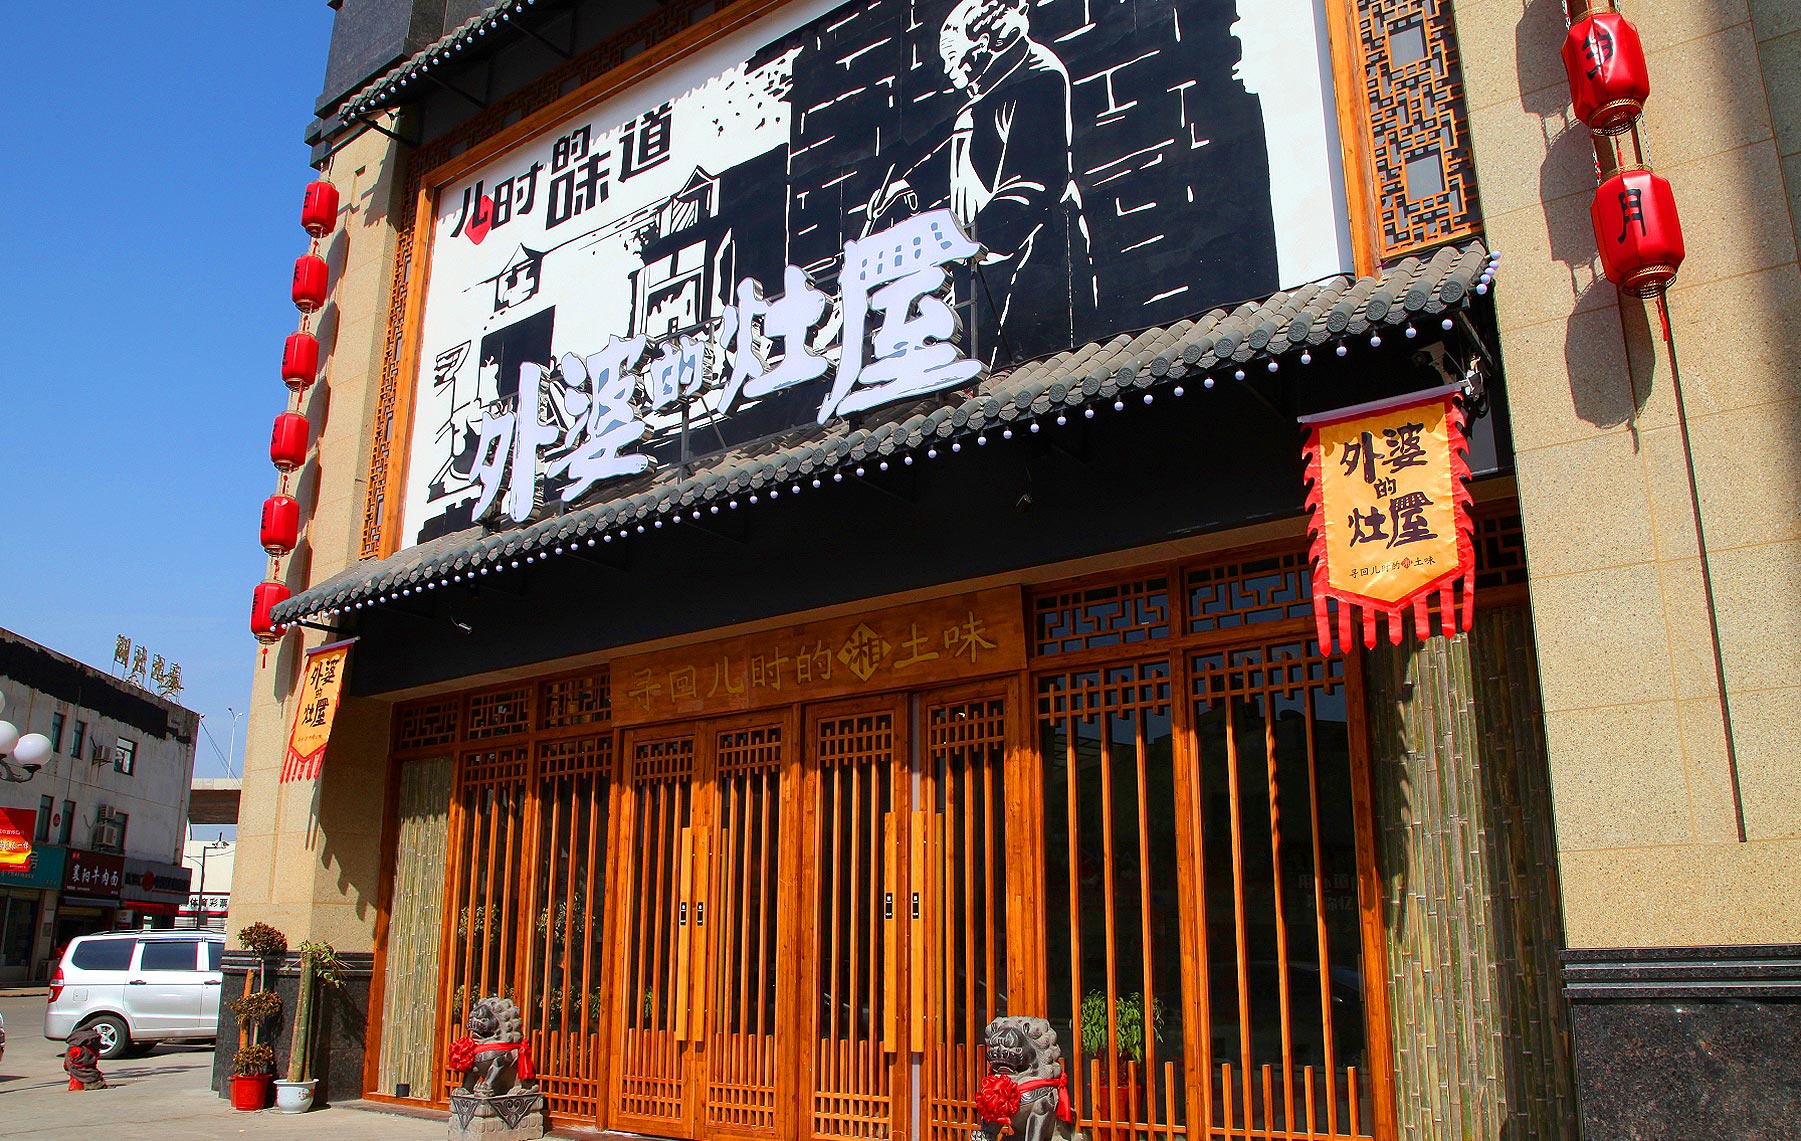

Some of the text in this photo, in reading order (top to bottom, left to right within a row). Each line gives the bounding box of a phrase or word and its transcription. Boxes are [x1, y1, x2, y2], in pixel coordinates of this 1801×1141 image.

[450, 101, 672, 237] 儿时的味道
[469, 208, 988, 524] 外婆的灶屋
[1340, 422, 1428, 483] 外婆
[1374, 477, 1397, 499] 的
[1348, 491, 1438, 550] 灶屋
[310, 658, 340, 690] 外婆
[628, 610, 998, 711] 寻回儿时的湘土味
[72, 863, 119, 887] 襄阳牛肉面
